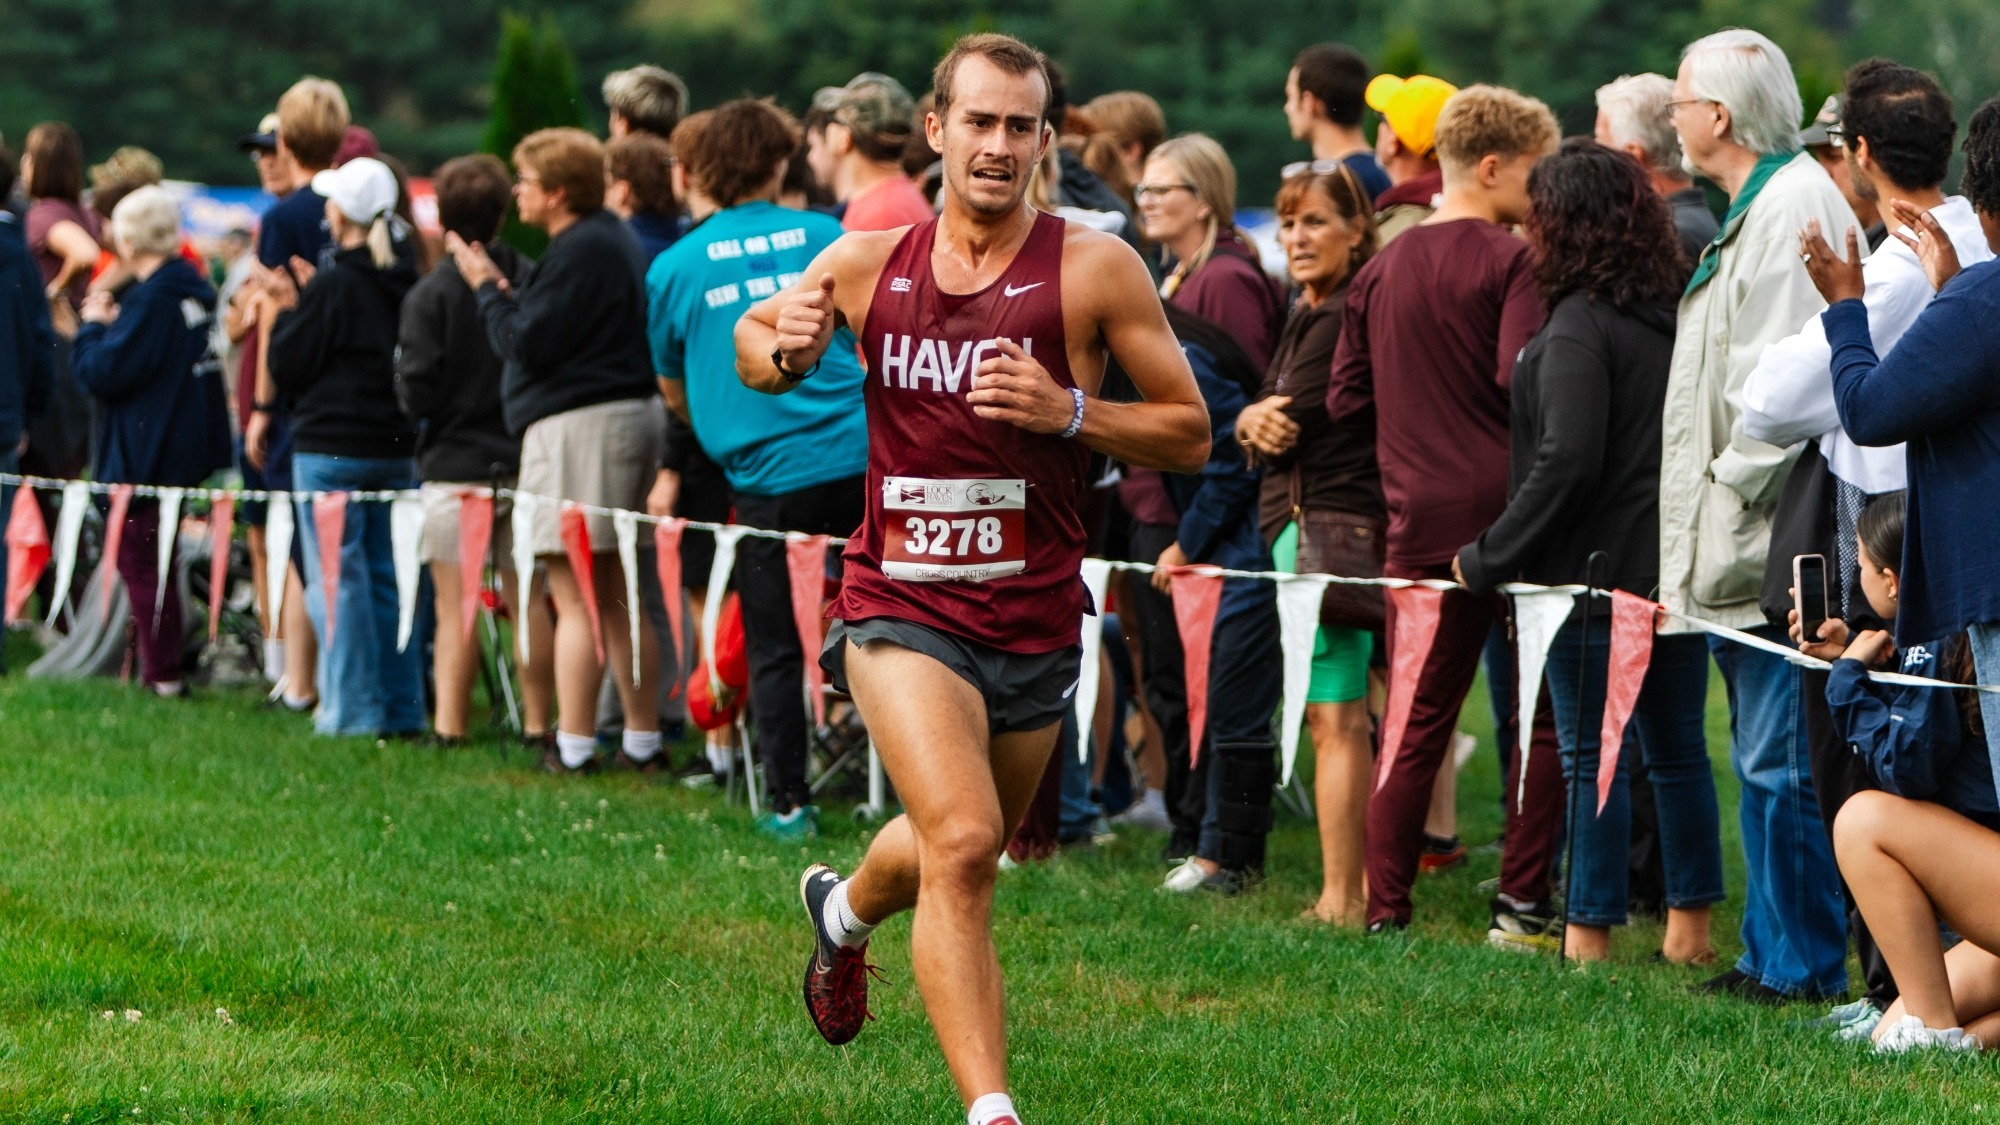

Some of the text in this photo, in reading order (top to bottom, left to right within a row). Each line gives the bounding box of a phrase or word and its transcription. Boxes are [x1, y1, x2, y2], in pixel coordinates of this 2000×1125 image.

[706, 228, 806, 261] CALL OR TEXT
[891, 279, 912, 289] PSAC
[926, 485, 952, 494] LOCK
[926, 493, 952, 501] HAVEN
[905, 516, 1003, 556] 3278
[915, 567, 990, 579] CROSS COUNTRY
